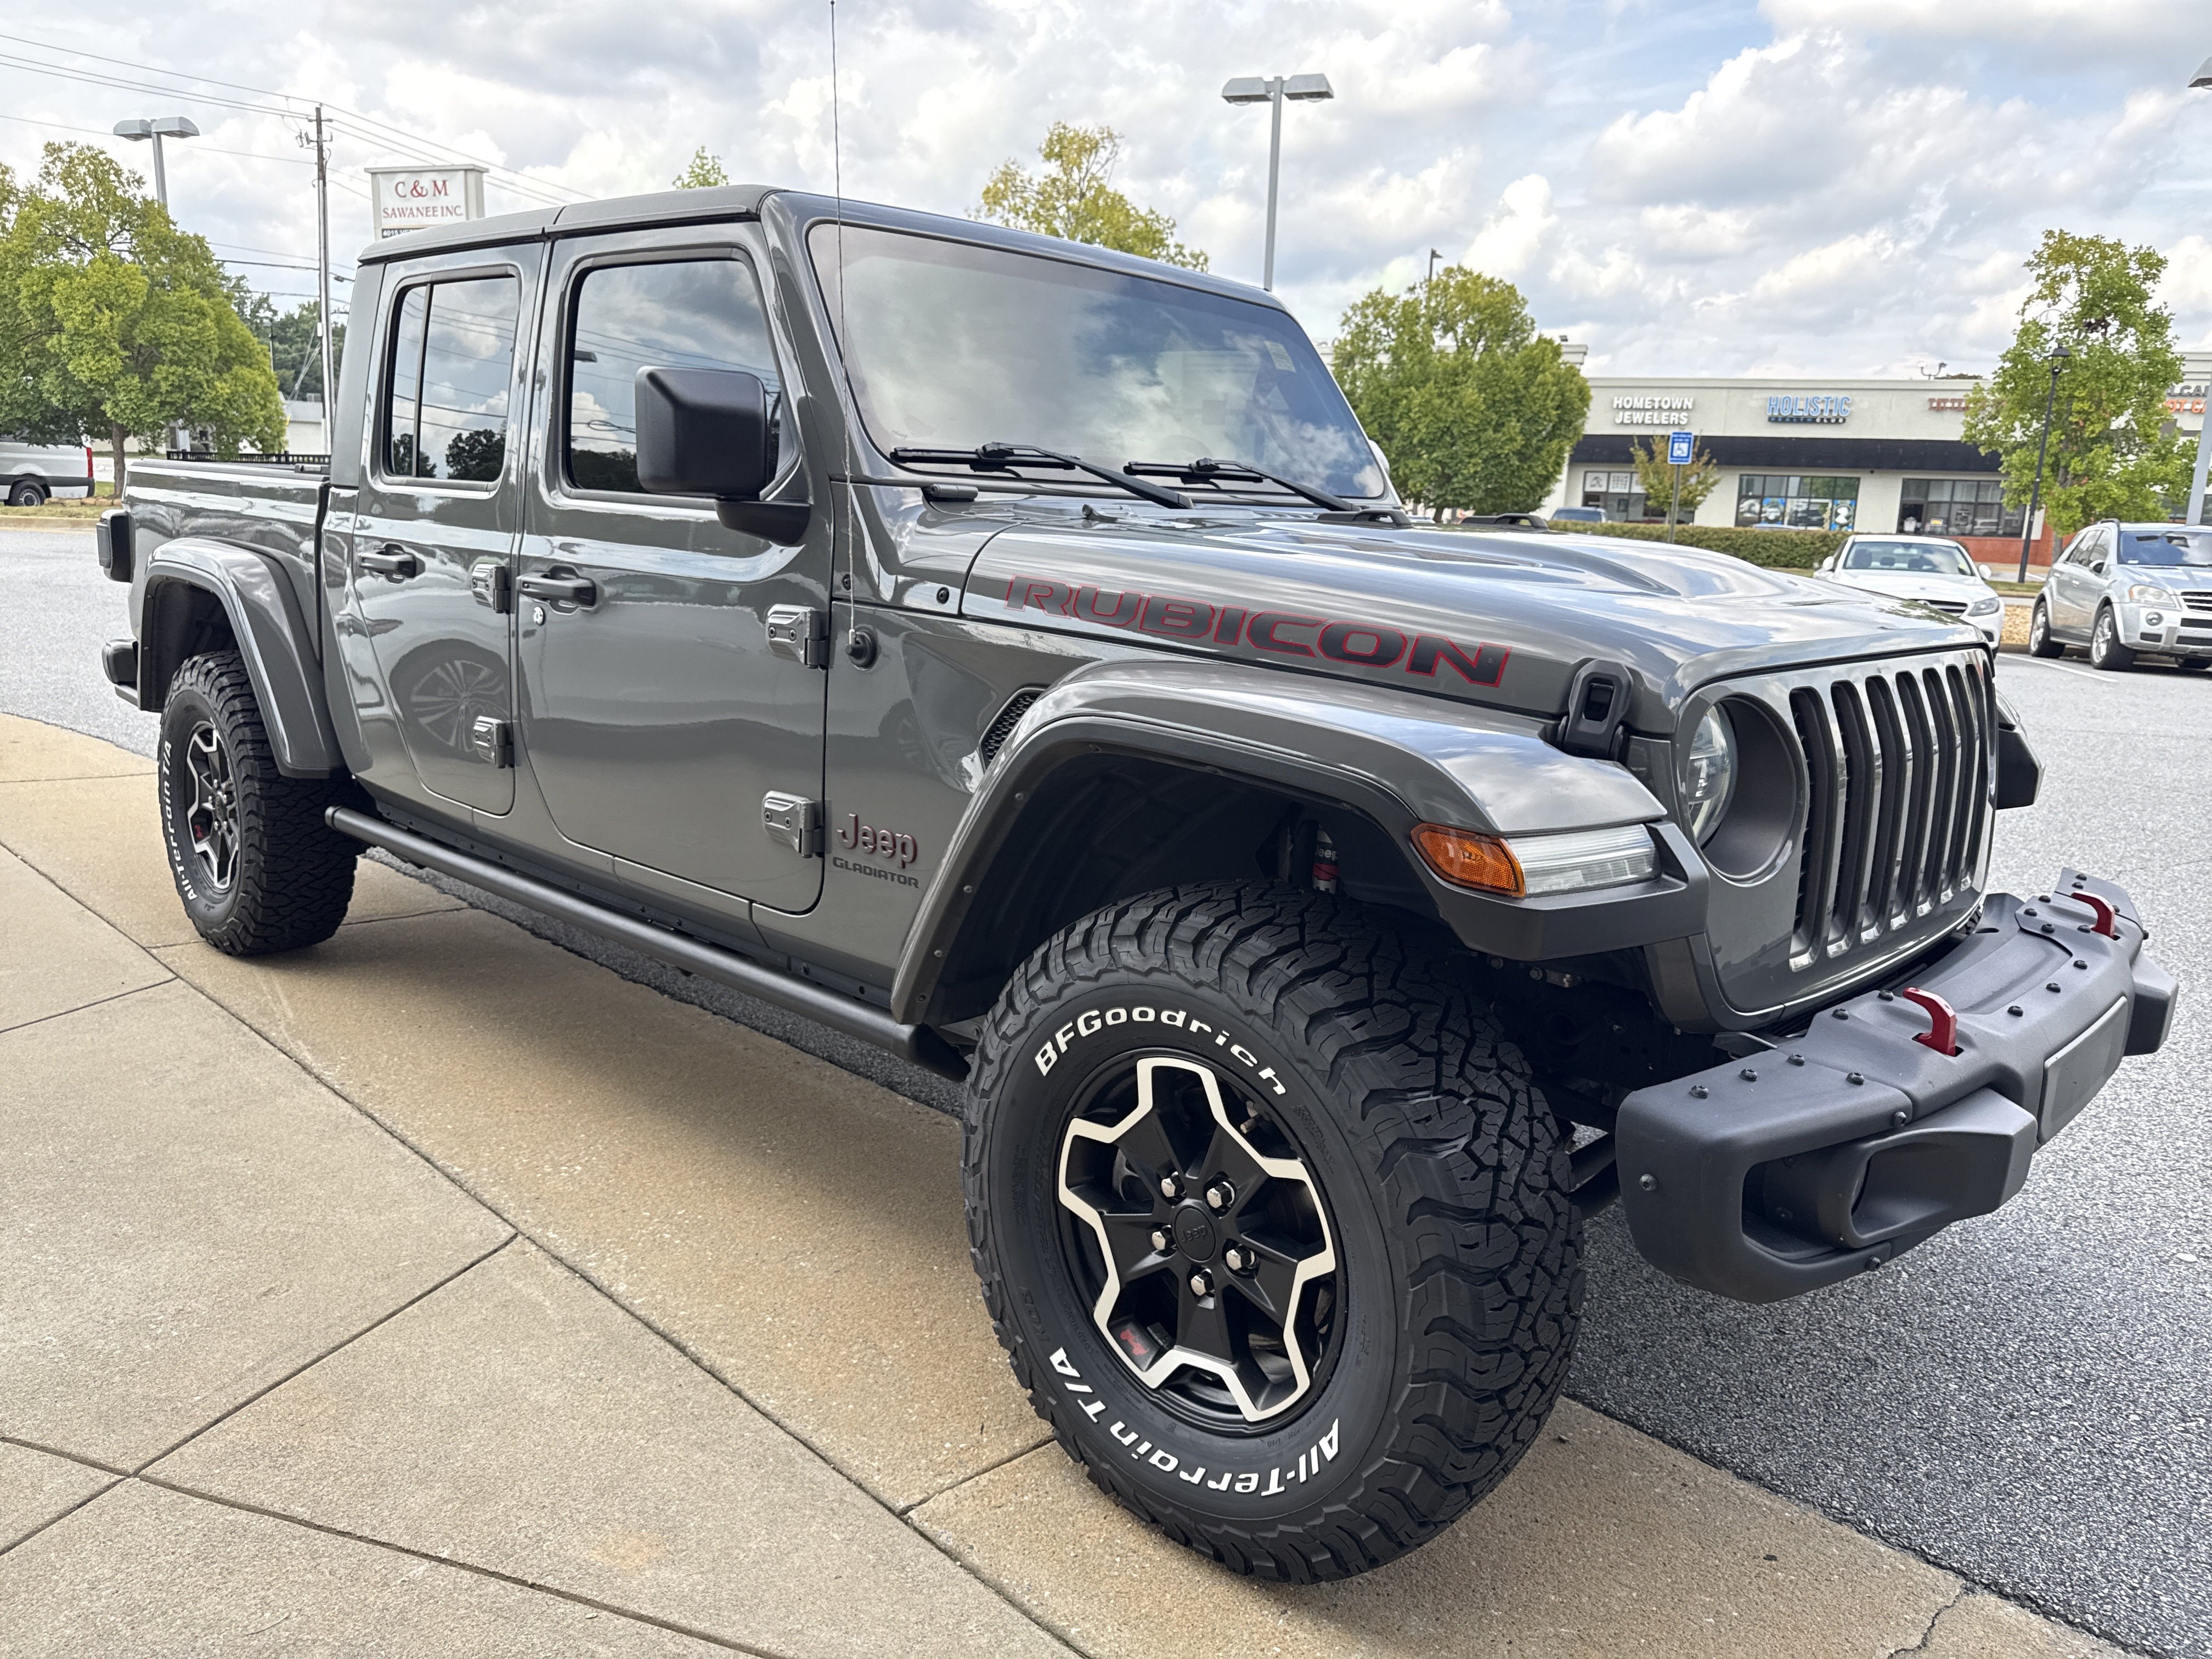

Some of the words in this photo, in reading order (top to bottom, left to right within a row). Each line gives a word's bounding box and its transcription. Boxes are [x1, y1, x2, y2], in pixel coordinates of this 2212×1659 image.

[394, 181, 407, 198] C
[410, 179, 428, 198] &
[432, 179, 450, 197] M
[382, 206, 439, 219] SAWANEE
[1612, 396, 1694, 410] HOMETOWN
[1615, 411, 1689, 425] JEWELERS
[1766, 394, 1852, 417] HOLISTIC
[1005, 574, 1513, 688] RUBICON
[162, 741, 172, 776] T/A
[837, 813, 918, 870] Jeep
[832, 856, 920, 889] GLADIATOR
[1034, 1006, 1287, 1096] BFGoodrich
[1181, 1224, 1208, 1244] Jeep
[1049, 1347, 1107, 1424] T/A
[1109, 1417, 1340, 1497] All-Terrain
